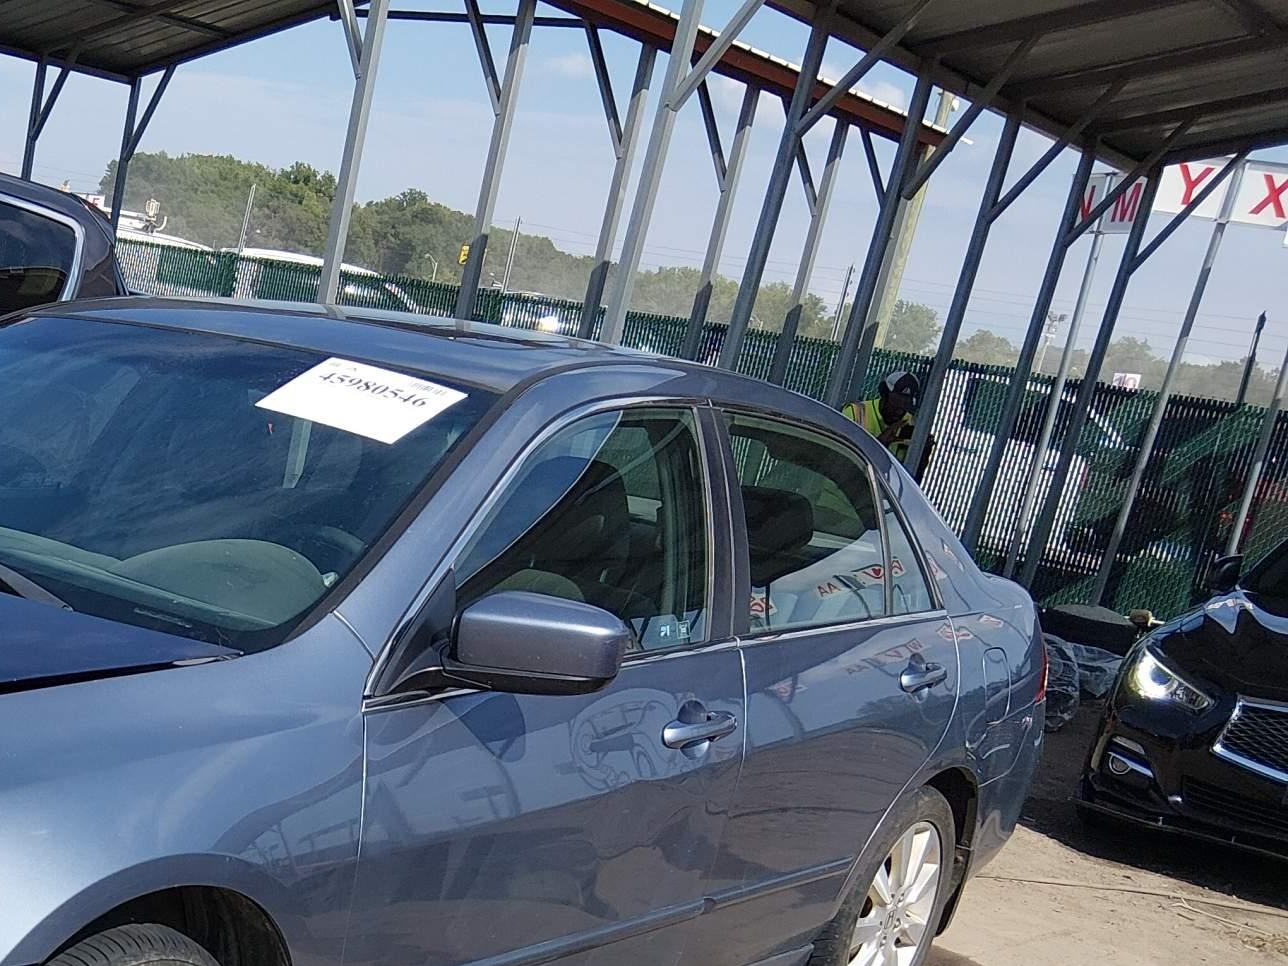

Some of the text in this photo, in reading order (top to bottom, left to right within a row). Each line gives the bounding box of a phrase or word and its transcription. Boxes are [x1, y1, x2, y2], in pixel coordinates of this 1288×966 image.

[1110, 182, 1142, 222] M
[1180, 161, 1288, 218] Y X
[319, 372, 430, 408] 45980546
